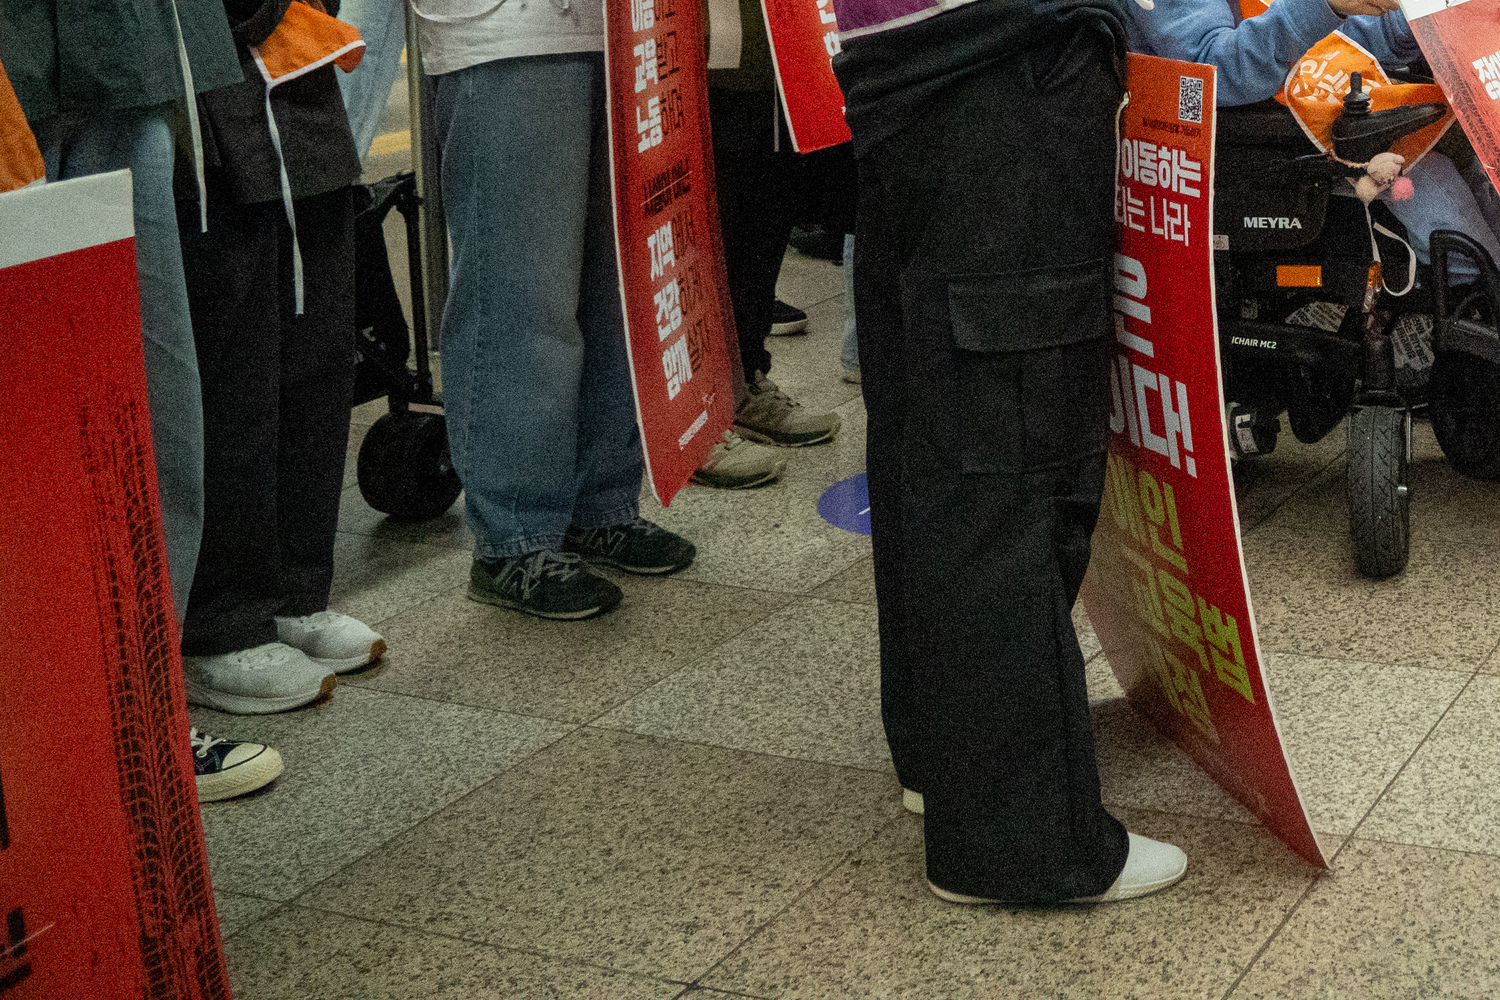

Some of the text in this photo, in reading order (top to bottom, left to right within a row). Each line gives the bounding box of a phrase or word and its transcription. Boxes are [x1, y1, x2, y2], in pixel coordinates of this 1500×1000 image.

[1122, 138, 1202, 199] 이동하는
[1150, 195, 1192, 247] 나라
[1243, 216, 1303, 230] MEYRA
[1259, 339, 1278, 350] MC2
